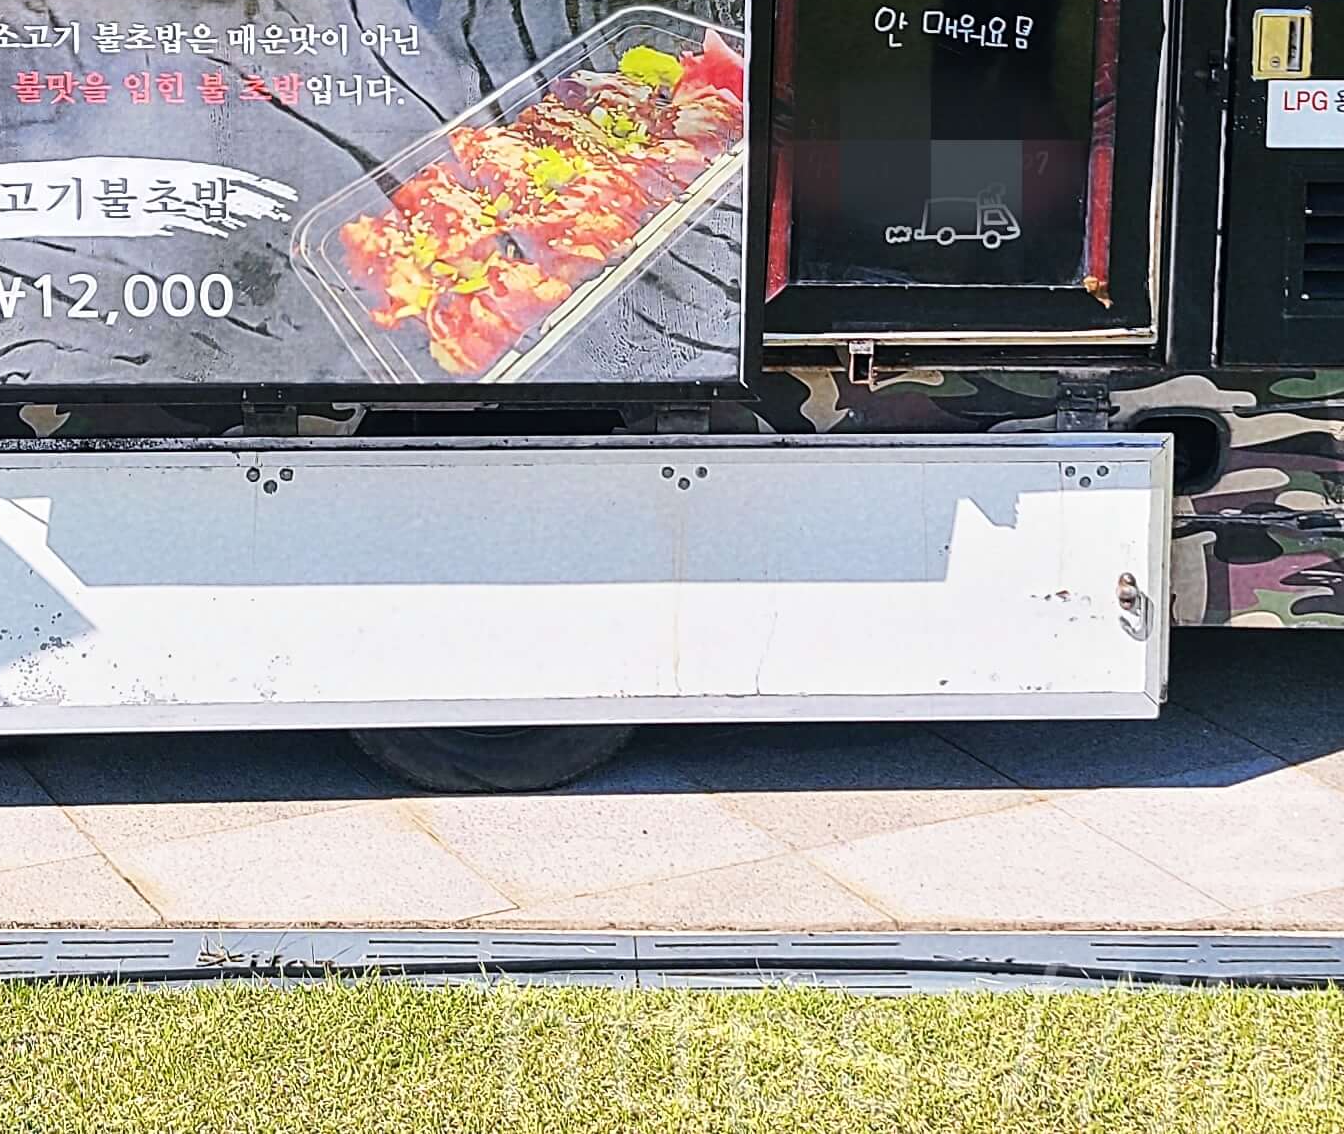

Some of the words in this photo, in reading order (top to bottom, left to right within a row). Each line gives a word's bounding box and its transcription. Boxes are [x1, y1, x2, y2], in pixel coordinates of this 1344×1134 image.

[93, 22, 219, 55] 불초밥은
[227, 22, 349, 56] 매운맛이
[359, 23, 421, 57] 아닌
[874, 6, 909, 48] 안
[11, 71, 112, 105] 불맛을
[128, 71, 185, 104] 입힌
[196, 72, 230, 106] 불
[238, 72, 405, 108] 초밥입니다.
[1283, 90, 1328, 111] LPG
